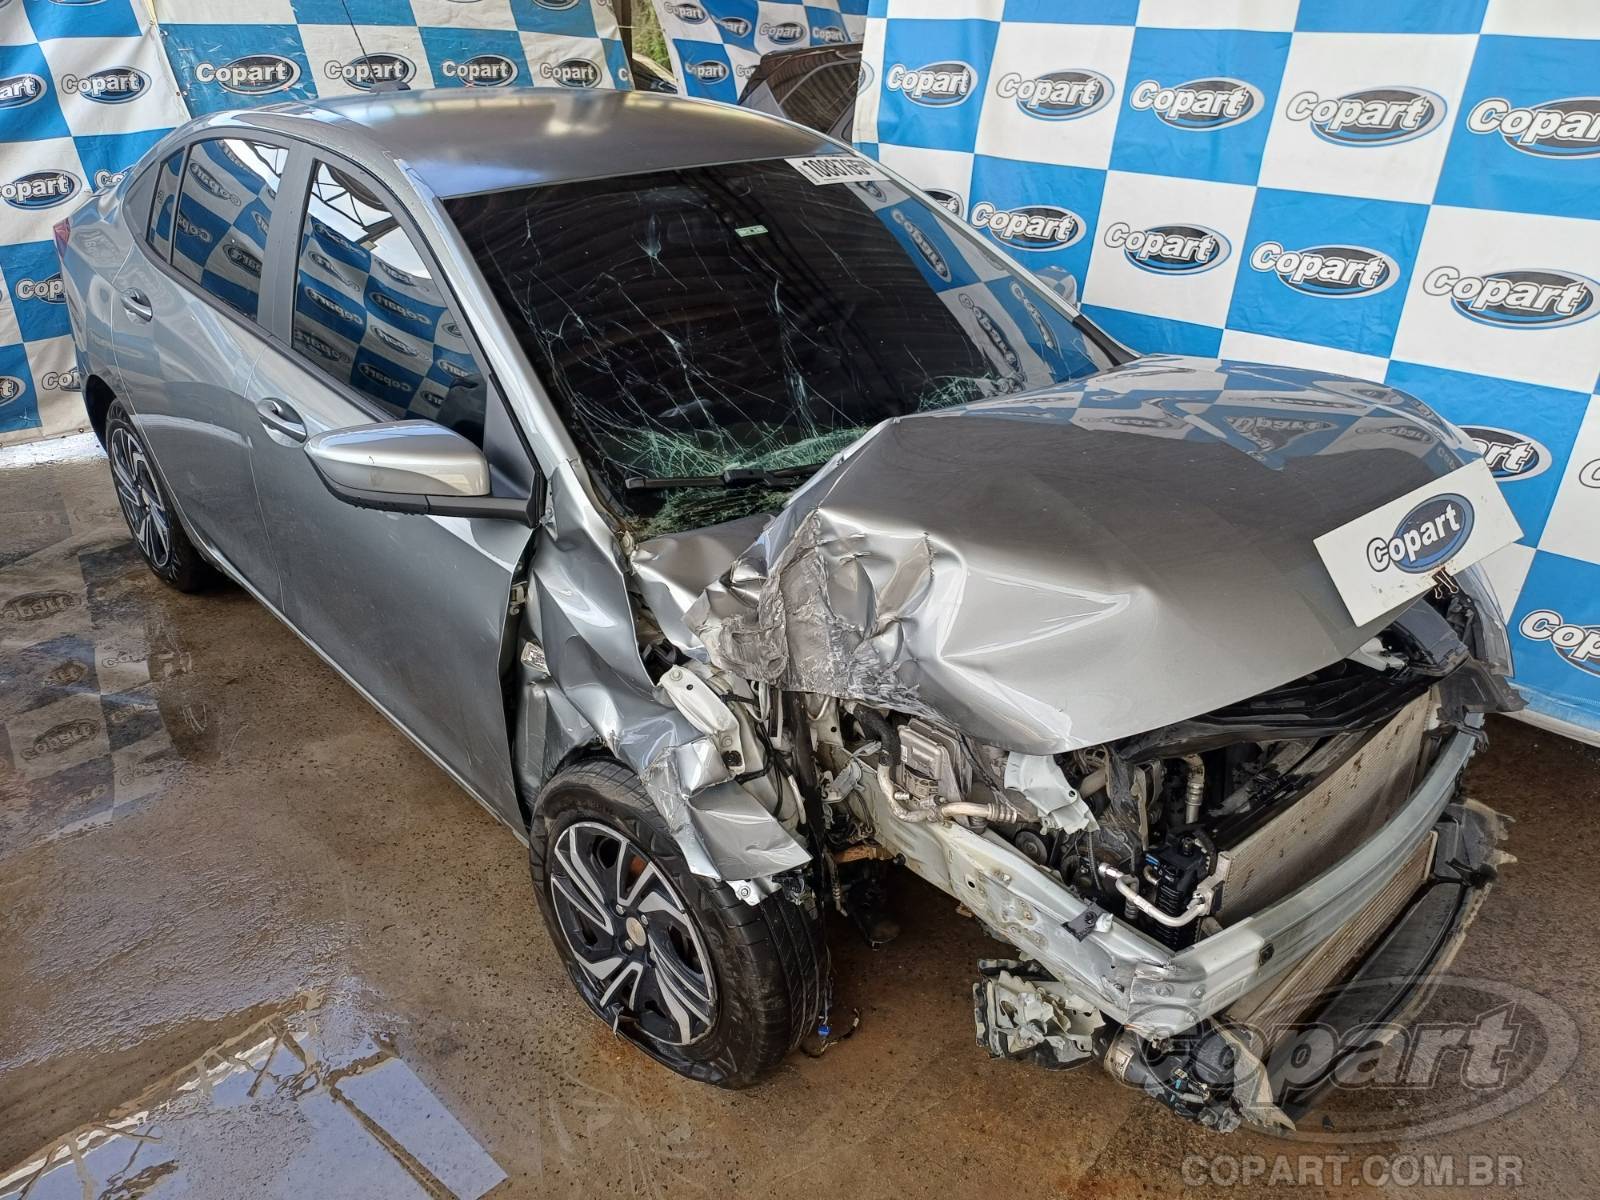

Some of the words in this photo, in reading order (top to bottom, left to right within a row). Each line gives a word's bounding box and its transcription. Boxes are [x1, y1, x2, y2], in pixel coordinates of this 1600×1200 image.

[760, 23, 802, 40] Copart
[812, 27, 844, 41] Copart
[61, 72, 140, 95] Copart
[196, 61, 288, 84] Copart
[324, 60, 403, 81] Copart
[442, 60, 508, 79] Copart
[540, 62, 597, 80] Copart
[887, 64, 973, 97] Copart
[0, 76, 36, 99] art
[996, 73, 1102, 108] Copart
[1130, 80, 1249, 120] Copart
[1286, 91, 1431, 131] Copart
[1466, 98, 1600, 145] Copa
[0, 173, 69, 203] opart
[970, 201, 1076, 241] Copart
[1104, 222, 1218, 263] Copart
[1250, 241, 1386, 288] Copart
[16, 279, 63, 301] Cop
[1423, 265, 1587, 315] Copart
[1366, 502, 1461, 573] Copart
[1519, 609, 1600, 662] Cop
